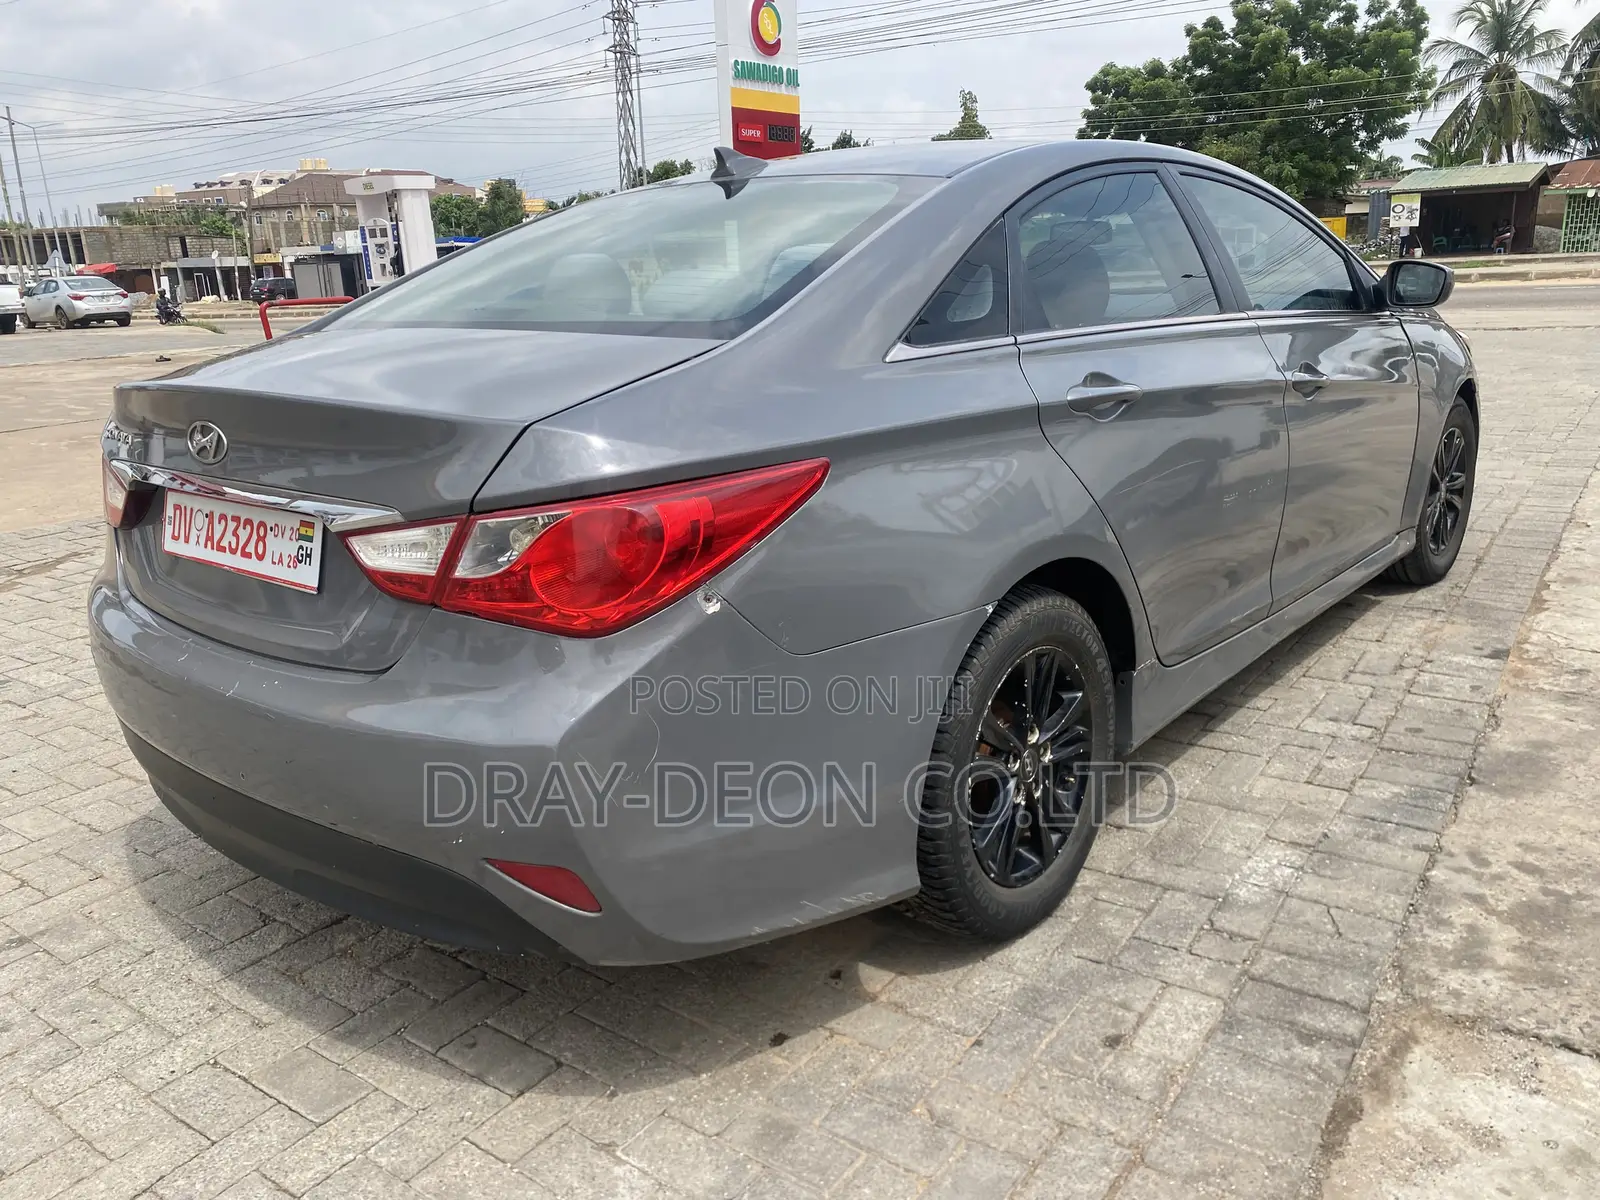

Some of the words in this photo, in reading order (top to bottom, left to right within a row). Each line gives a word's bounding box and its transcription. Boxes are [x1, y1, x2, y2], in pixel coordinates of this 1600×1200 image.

[733, 59, 784, 84] SAWADIGO
[786, 67, 800, 88] OIL
[741, 128, 761, 138] SUPER
[171, 503, 194, 545] DV
[204, 510, 268, 561] A2328
[273, 523, 286, 539] DV
[271, 550, 284, 567] LA
[296, 544, 313, 567] GH
